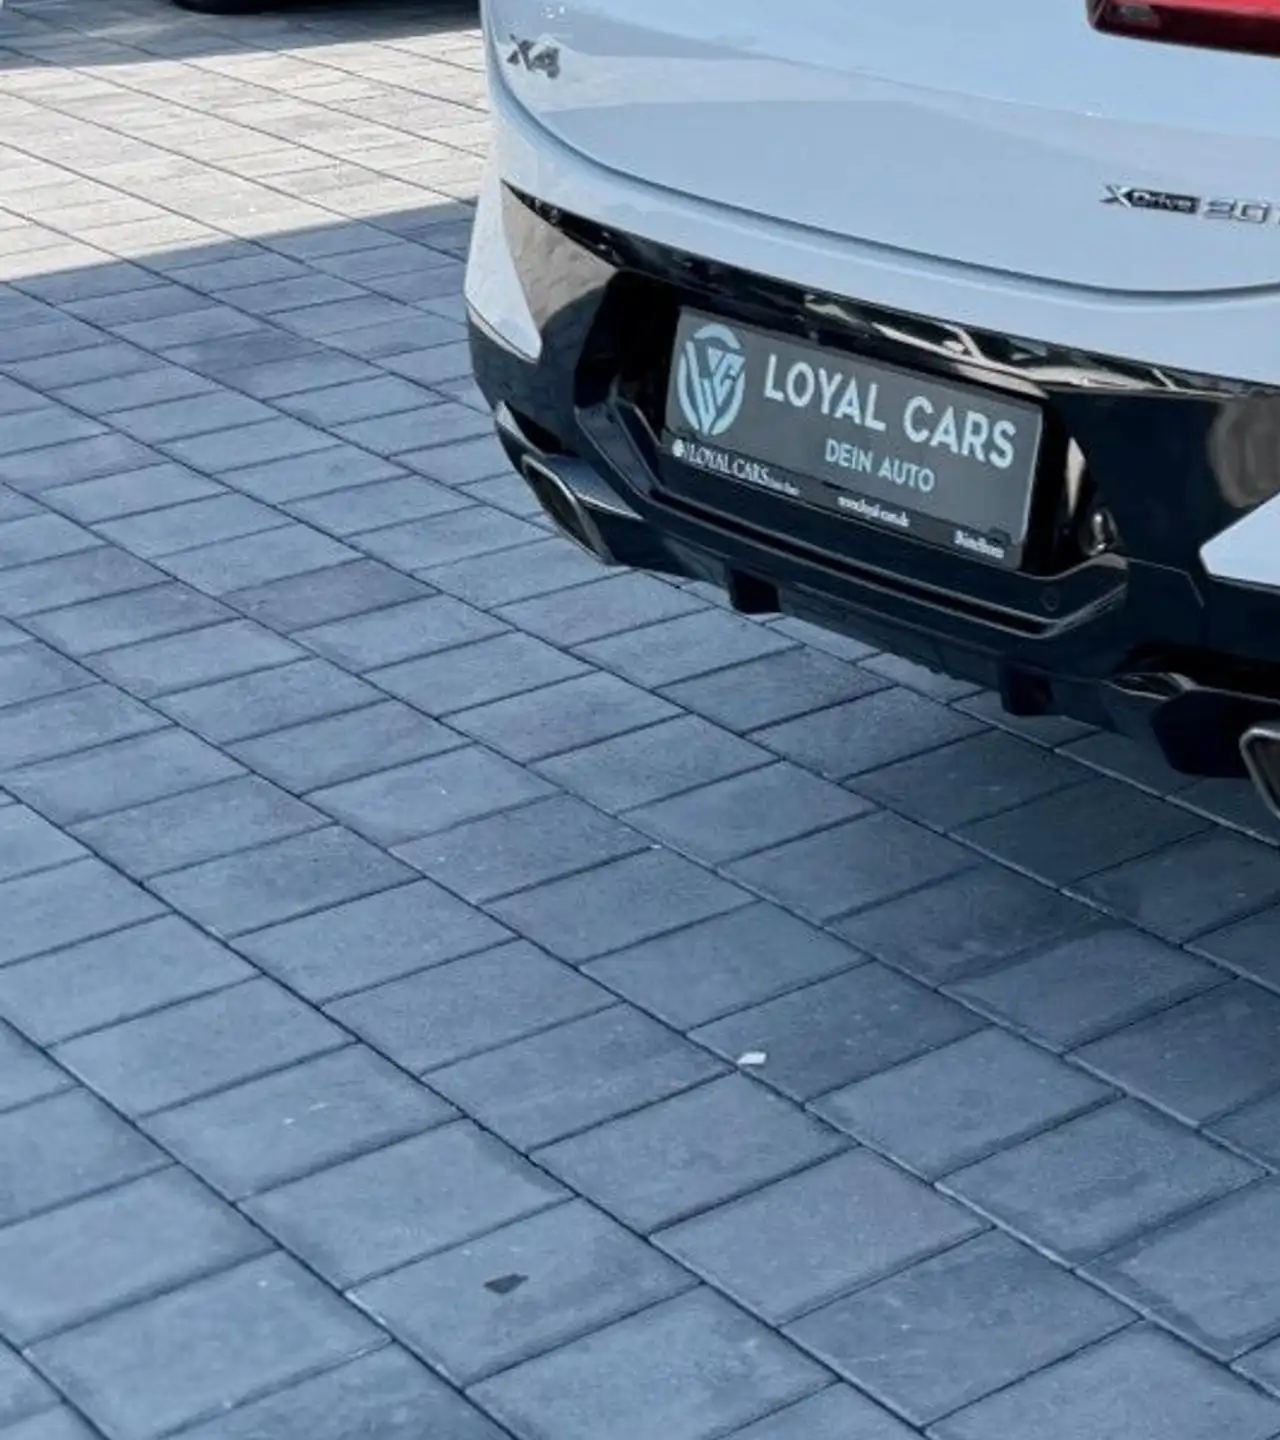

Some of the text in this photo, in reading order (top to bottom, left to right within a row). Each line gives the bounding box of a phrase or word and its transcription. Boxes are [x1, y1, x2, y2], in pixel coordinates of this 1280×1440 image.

[506, 33, 560, 79] X4
[763, 353, 1017, 469] LOYAL CARS
[824, 437, 936, 493] DEIN AUTO
